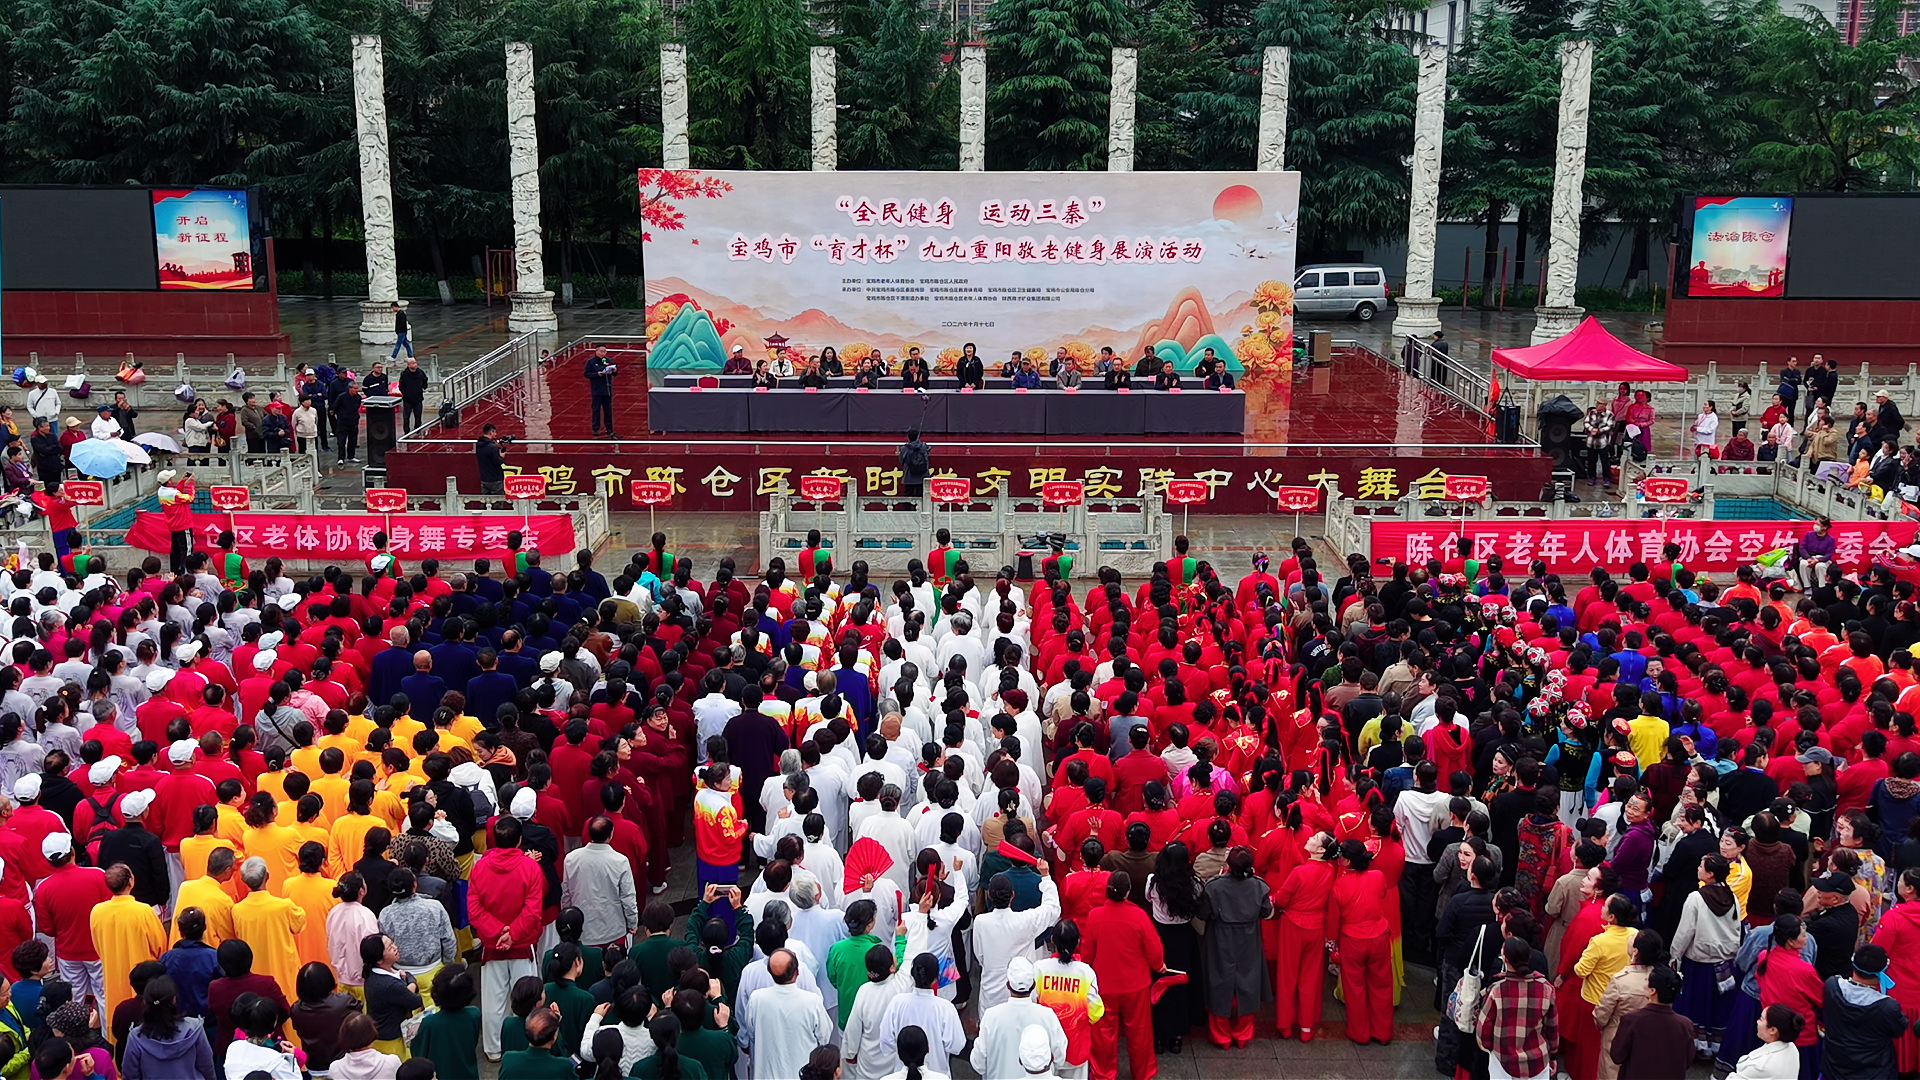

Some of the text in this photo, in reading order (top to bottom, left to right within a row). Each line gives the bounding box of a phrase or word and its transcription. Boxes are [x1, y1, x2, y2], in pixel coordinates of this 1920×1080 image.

[176, 216, 208, 225] 开启
[839, 200, 1102, 225] “全民健身 运动三秦”
[178, 232, 229, 243] 新征程
[731, 237, 1202, 261] 宝鸡市 “育才杯” 九九重阳敬老健身展演活动
[1707, 231, 1776, 243] 法治陈仓
[501, 463, 1448, 499] 鸡市陈仓区时文明实践中心大舞台
[193, 523, 540, 552] 仓区老体协健身舞专委会
[1405, 529, 1897, 566] 陈仓区老年人体育协会空竹委会
[1043, 975, 1080, 994] CHINA
